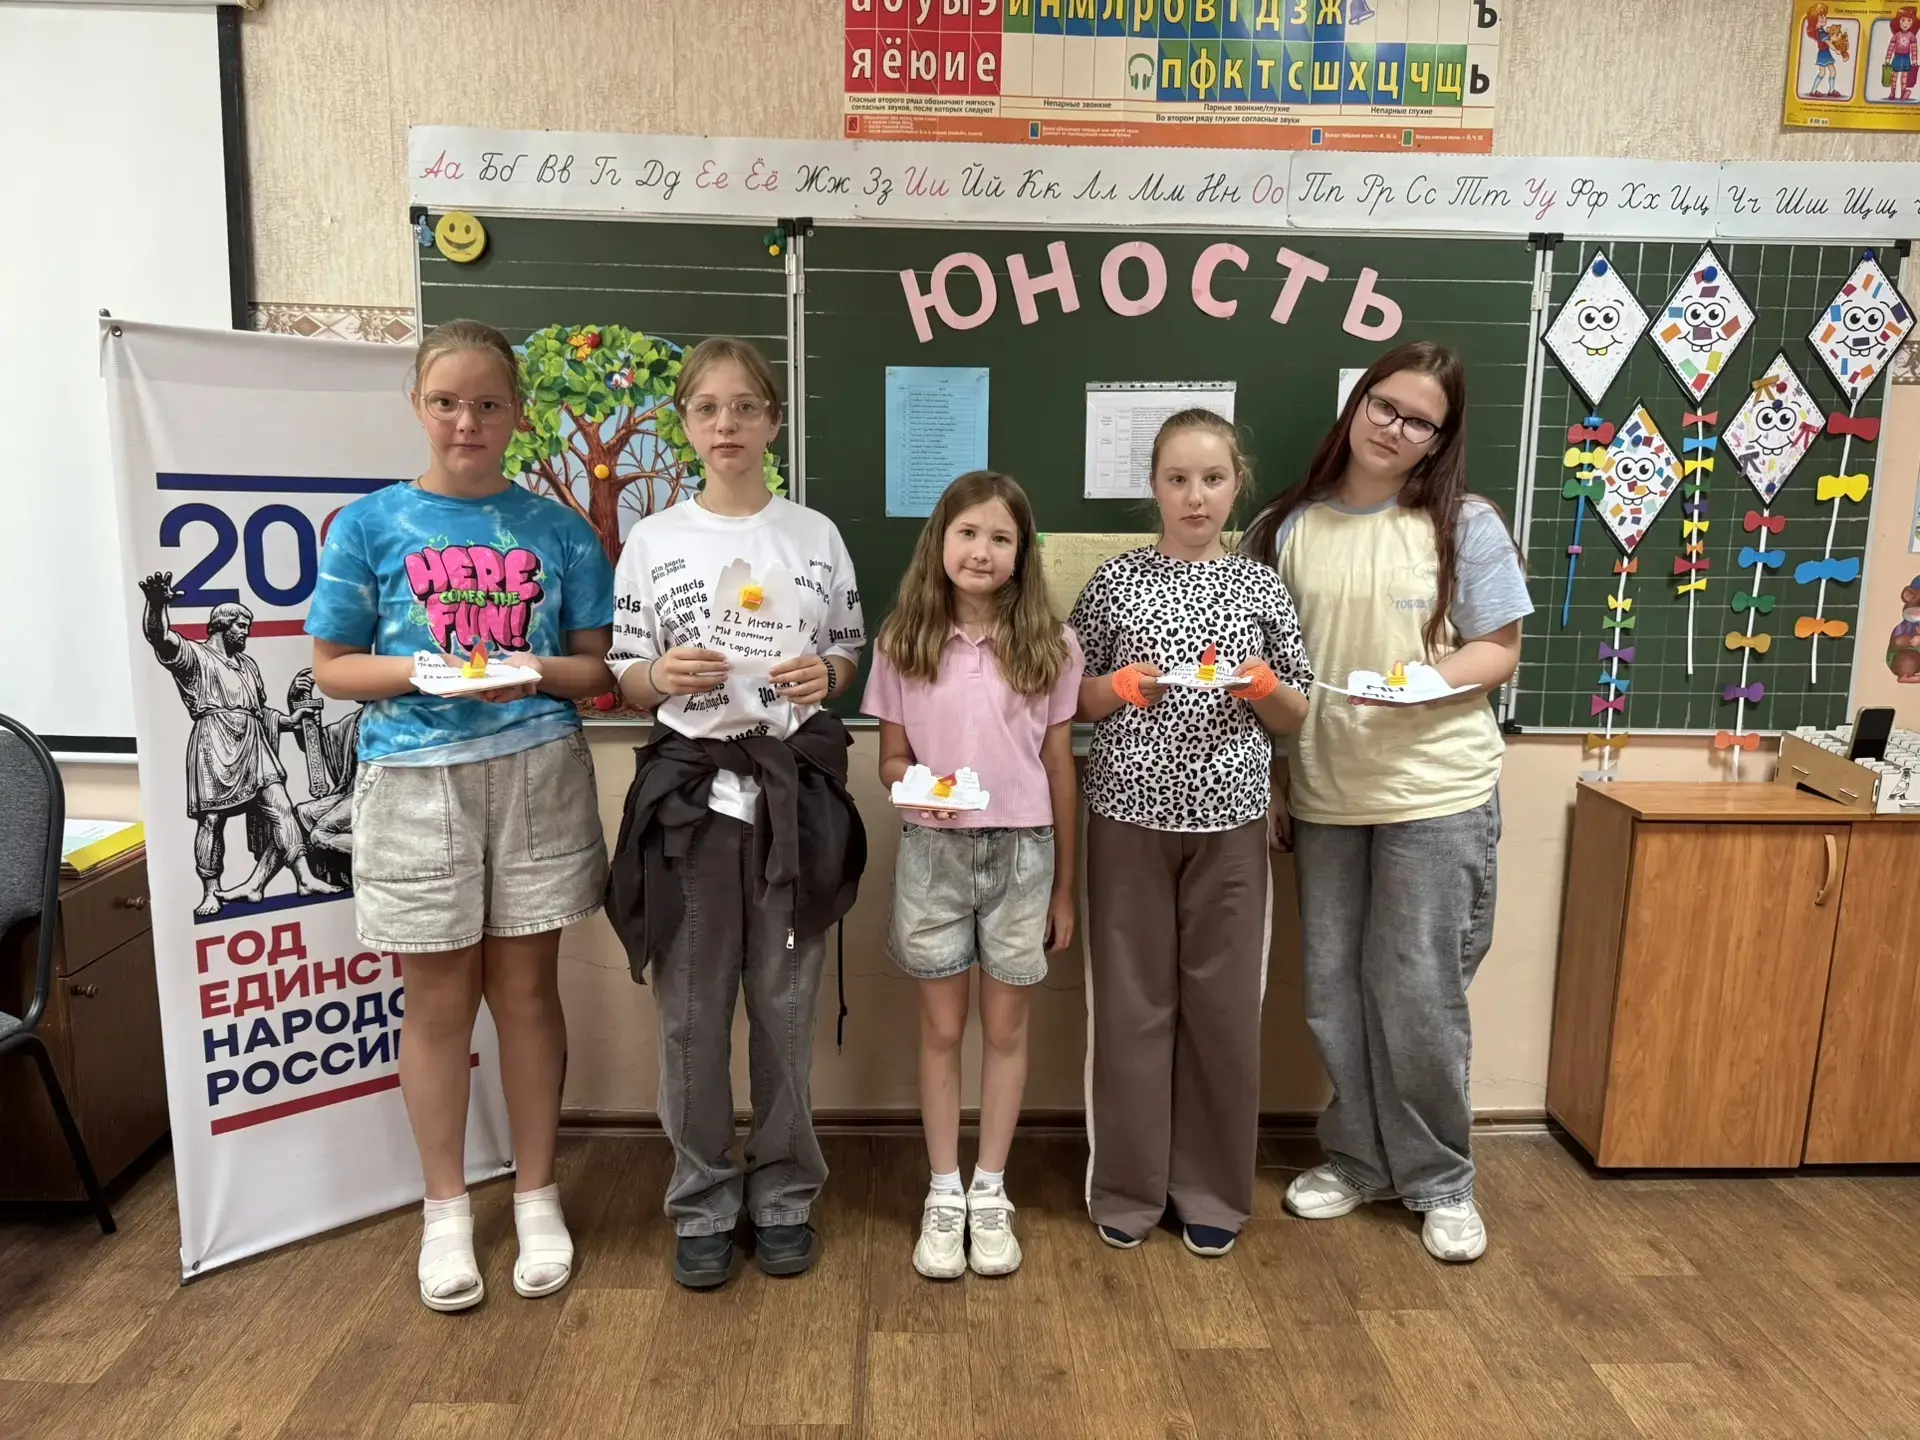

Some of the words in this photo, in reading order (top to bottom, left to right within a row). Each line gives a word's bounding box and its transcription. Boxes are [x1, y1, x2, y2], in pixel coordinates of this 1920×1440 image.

[924, 98, 964, 106] обозначают
[1043, 100, 1080, 109] Непарные
[1203, 104, 1233, 113] Парные
[1234, 104, 1290, 113] звонкие/глухие
[1371, 107, 1407, 116] Непарные
[1409, 108, 1433, 116] глухие
[1156, 114, 1165, 122] Во
[1196, 116, 1213, 124] ряду
[1215, 116, 1240, 124] глухие
[1241, 116, 1278, 124] согласные
[1280, 117, 1300, 125] звуки
[419, 150, 464, 181] Аа
[479, 152, 528, 183] Бб
[536, 154, 575, 185] Вв
[589, 156, 622, 186] Гг
[635, 159, 681, 200] Дд
[695, 159, 729, 190] Ее
[745, 158, 780, 192] Ёё
[795, 164, 850, 196] Жж
[862, 167, 893, 205] Зз
[905, 166, 949, 197] Ии
[961, 161, 1005, 198] Йй
[1016, 168, 1062, 201] Кк
[1073, 169, 1117, 202] Лл
[1128, 173, 1186, 203] Мм
[1196, 173, 1241, 205] Нн
[1252, 173, 1284, 205] Оо
[1298, 172, 1345, 204] Пп
[1356, 173, 1395, 216] Рр
[1405, 174, 1438, 207] Сс
[1447, 175, 1512, 208] Тт
[1522, 177, 1557, 221] Уу
[1566, 177, 1609, 220] Фф
[1618, 181, 1661, 211] Хх
[1670, 184, 1710, 217] Цц
[1727, 185, 1763, 214] Чч
[1775, 187, 1829, 215] Шш
[1843, 186, 1898, 220] Щщ
[900, 240, 1403, 344] ЮНОСТЬ
[159, 502, 345, 608] 20
[404, 545, 541, 602] HERE
[439, 589, 487, 607] COMES
[489, 591, 521, 606] THE
[426, 594, 528, 648] FUN!
[723, 609, 742, 624] 22
[735, 631, 773, 642] помним
[729, 643, 782, 657] гордимся
[195, 921, 307, 974] ГОД
